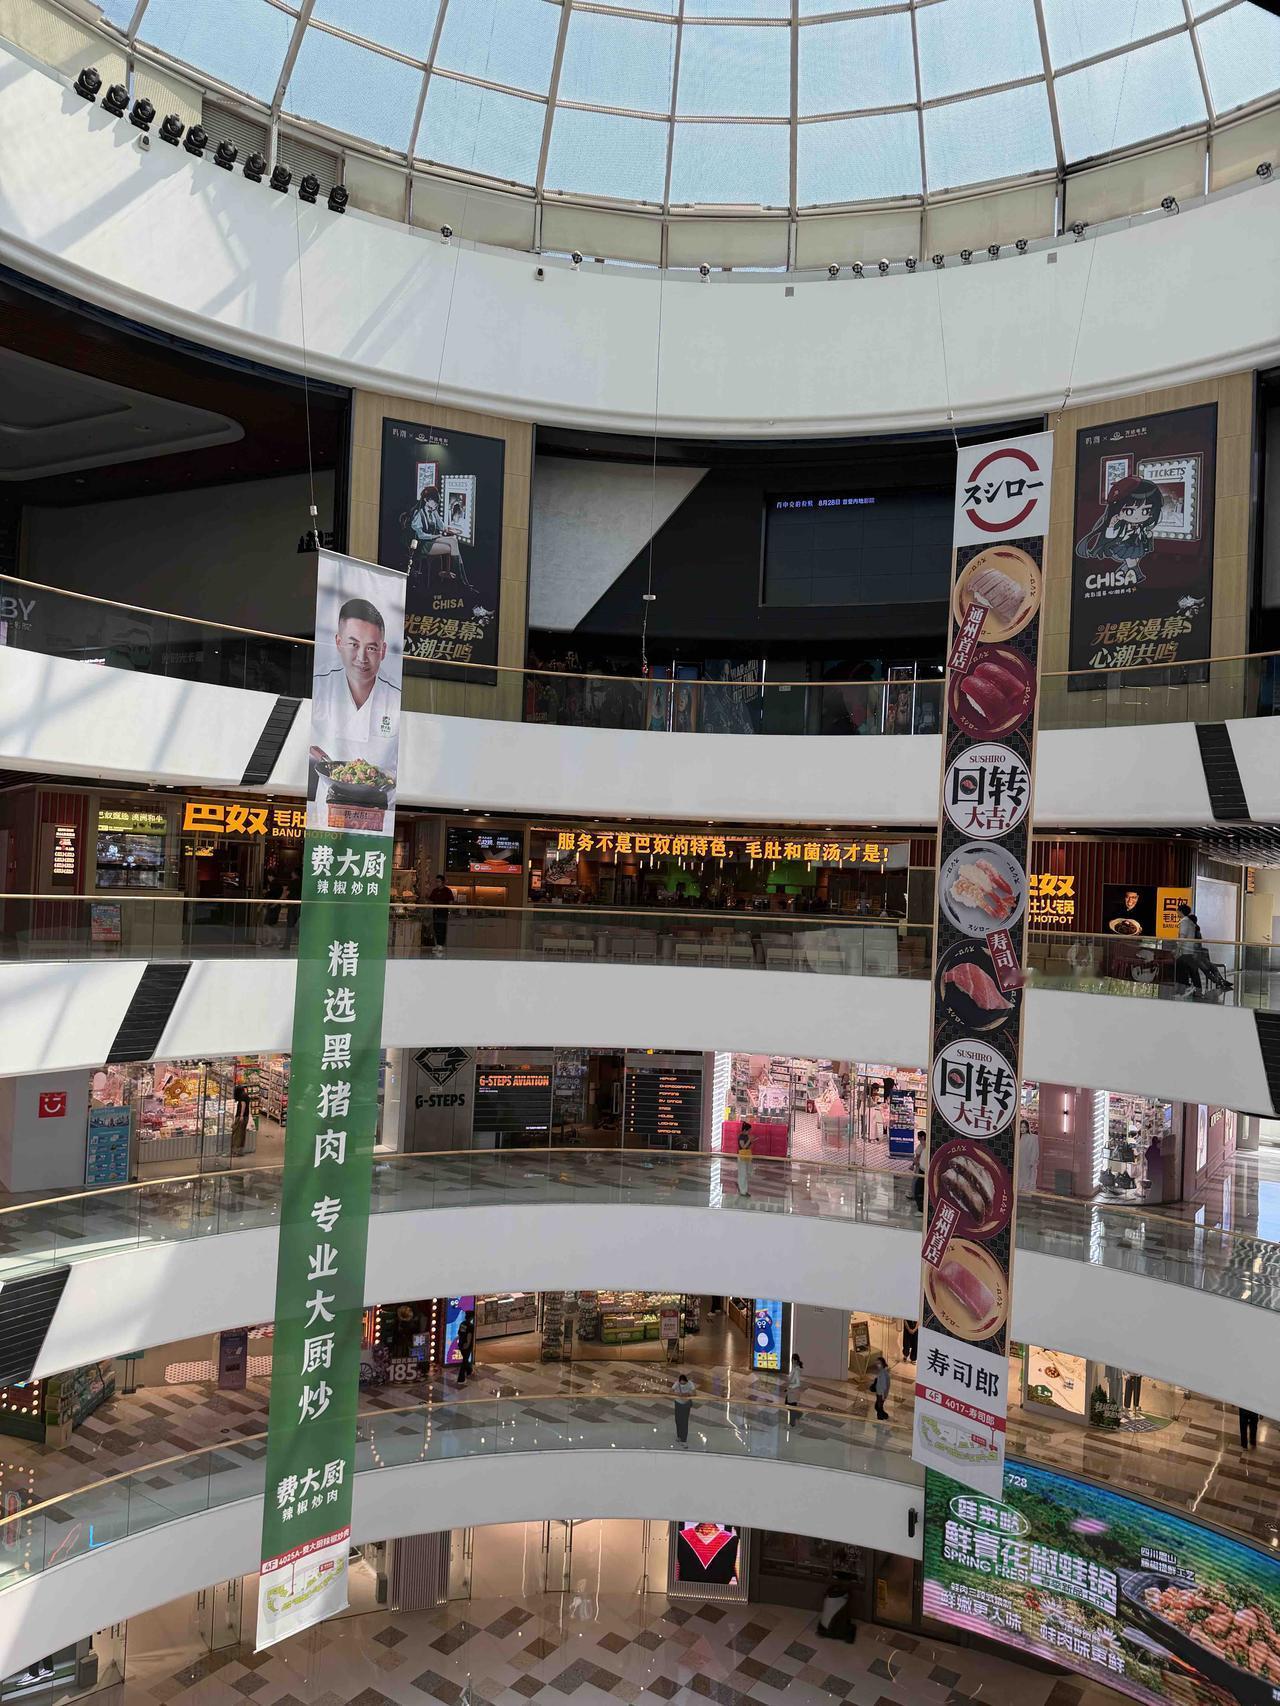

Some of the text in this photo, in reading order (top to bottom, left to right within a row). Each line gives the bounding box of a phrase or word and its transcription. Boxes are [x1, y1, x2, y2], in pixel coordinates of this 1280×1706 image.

[1149, 466, 1187, 479] TICKETS
[961, 478, 1044, 508] スシロー
[1085, 569, 1138, 589] CHISA
[432, 599, 464, 610] CHISA
[951, 606, 985, 669] 通州首店
[1090, 615, 1192, 646] 光影漫幕
[1089, 641, 1179, 668] 心潮共鸣
[969, 755, 1006, 764] SUSHIRO
[952, 765, 1027, 807] 回转
[183, 802, 268, 834] 巴奴
[964, 805, 1019, 830] 大吉！
[272, 828, 301, 838] BANU
[311, 844, 387, 880] 费大厨
[317, 879, 379, 897] 辣椒炒肉
[1034, 915, 1074, 924] HOTPOT
[990, 933, 1017, 988] 寿司
[313, 940, 360, 1168] 精选黑猪肉
[956, 1048, 993, 1063] SUSHIRO
[940, 1057, 1014, 1111] 回转
[415, 1093, 465, 1109] G-STEPS
[953, 1100, 1005, 1132] 大吉！
[924, 1203, 956, 1264] 通州首店
[297, 1196, 342, 1424] 专业大厨炒
[386, 1363, 418, 1381] 185
[926, 1347, 1000, 1397] 寿司郎
[928, 1391, 996, 1425] 4F 4017-寿司郎
[276, 1457, 347, 1510] 费大厨
[282, 1489, 339, 1523] 辣椒炒肉
[264, 1560, 277, 1571] 4F
[943, 1545, 992, 1573] SPRING
